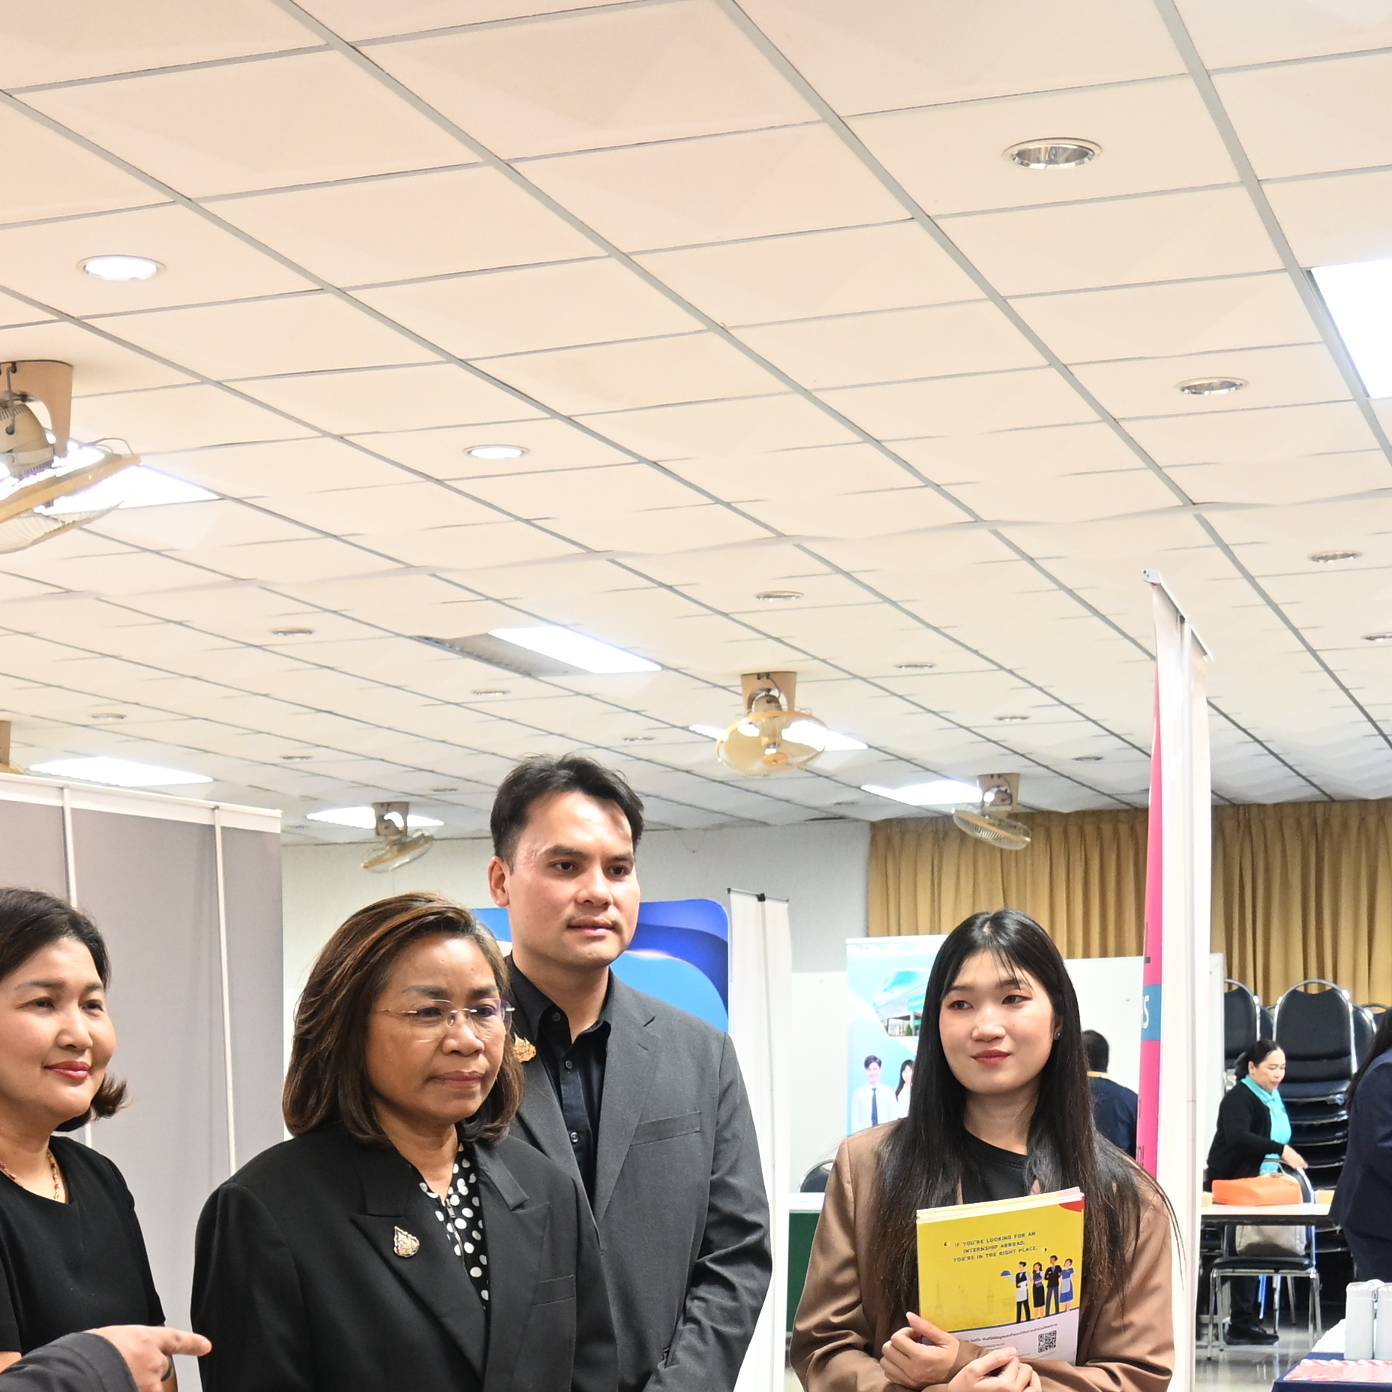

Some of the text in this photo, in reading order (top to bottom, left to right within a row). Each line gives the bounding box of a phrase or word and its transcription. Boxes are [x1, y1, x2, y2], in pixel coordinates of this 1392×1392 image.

[986, 1235, 1012, 1243] LOOKING
[963, 1244, 998, 1254] INTERNSHIP
[999, 1249, 1017, 1257] RIGHT
